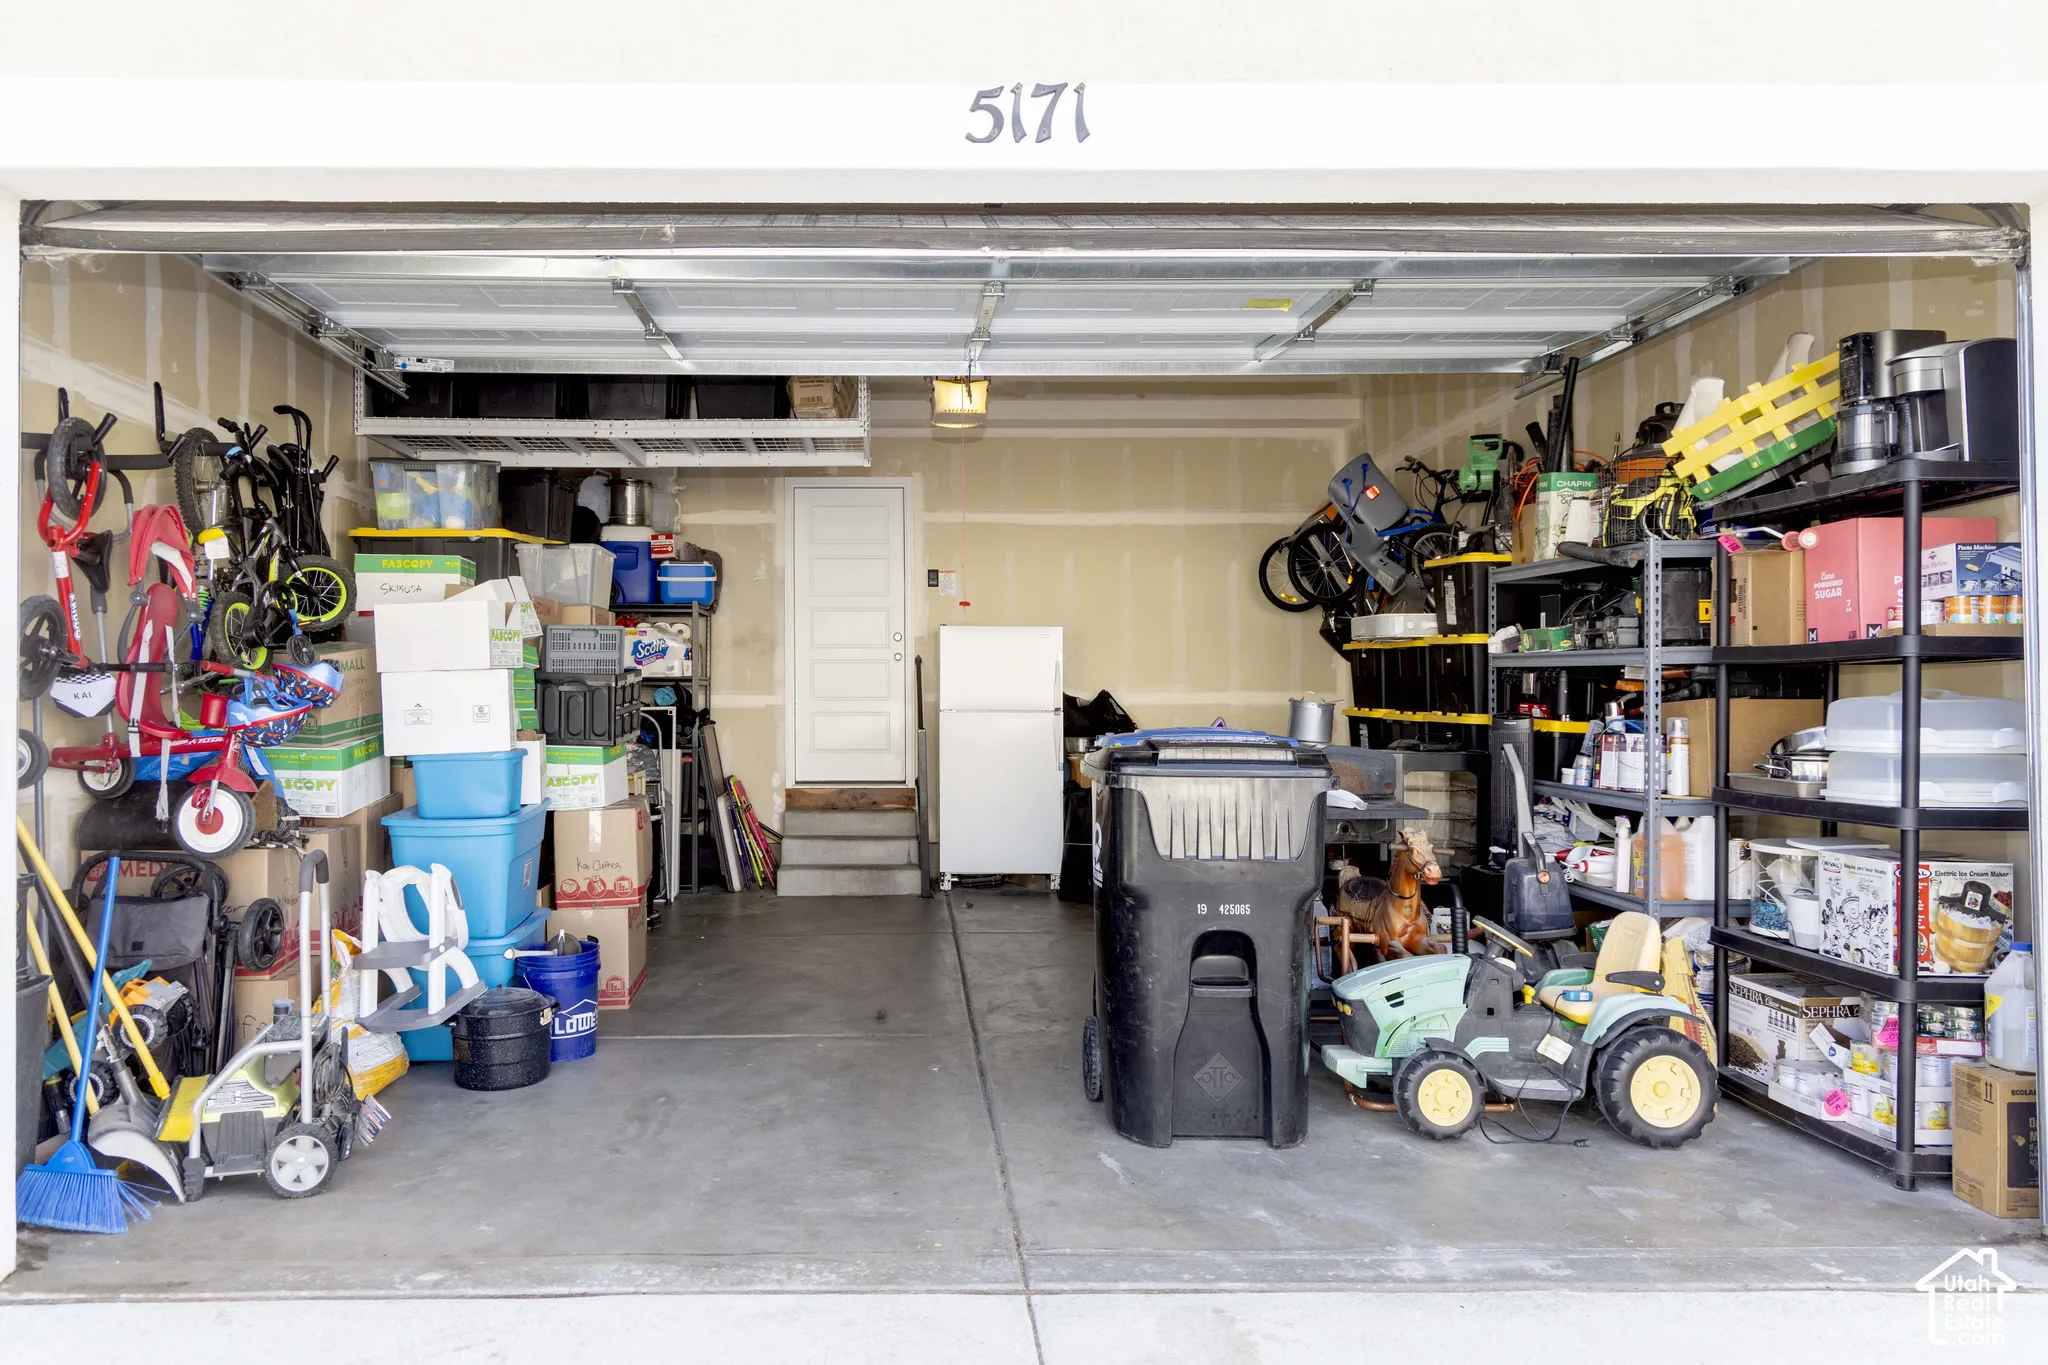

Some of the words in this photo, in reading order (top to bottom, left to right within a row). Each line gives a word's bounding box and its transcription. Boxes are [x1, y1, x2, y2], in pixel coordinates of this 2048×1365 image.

[965, 81, 1090, 143] 5171
[381, 559, 435, 569] FASCOPY
[1813, 579, 1844, 589] POWDERED
[1814, 588, 1843, 599] SUGAR
[1846, 599, 1852, 607] 7
[491, 629, 521, 641] FASCOPY
[636, 638, 665, 659] Scott
[341, 657, 365, 672] MALL
[73, 691, 92, 700] KAI
[354, 740, 380, 759] FASCOPY
[281, 779, 336, 791] SCOPY
[546, 773, 598, 787] ASCOPY
[1823, 860, 1840, 868] RIVAL
[1990, 870, 2009, 878] Maker
[1197, 903, 1208, 915] 19
[1219, 904, 1251, 915] 425065
[1729, 982, 1764, 1005] SEPHRA
[1802, 1005, 1852, 1018] SEPHRA
[554, 1009, 598, 1035] LOWE
